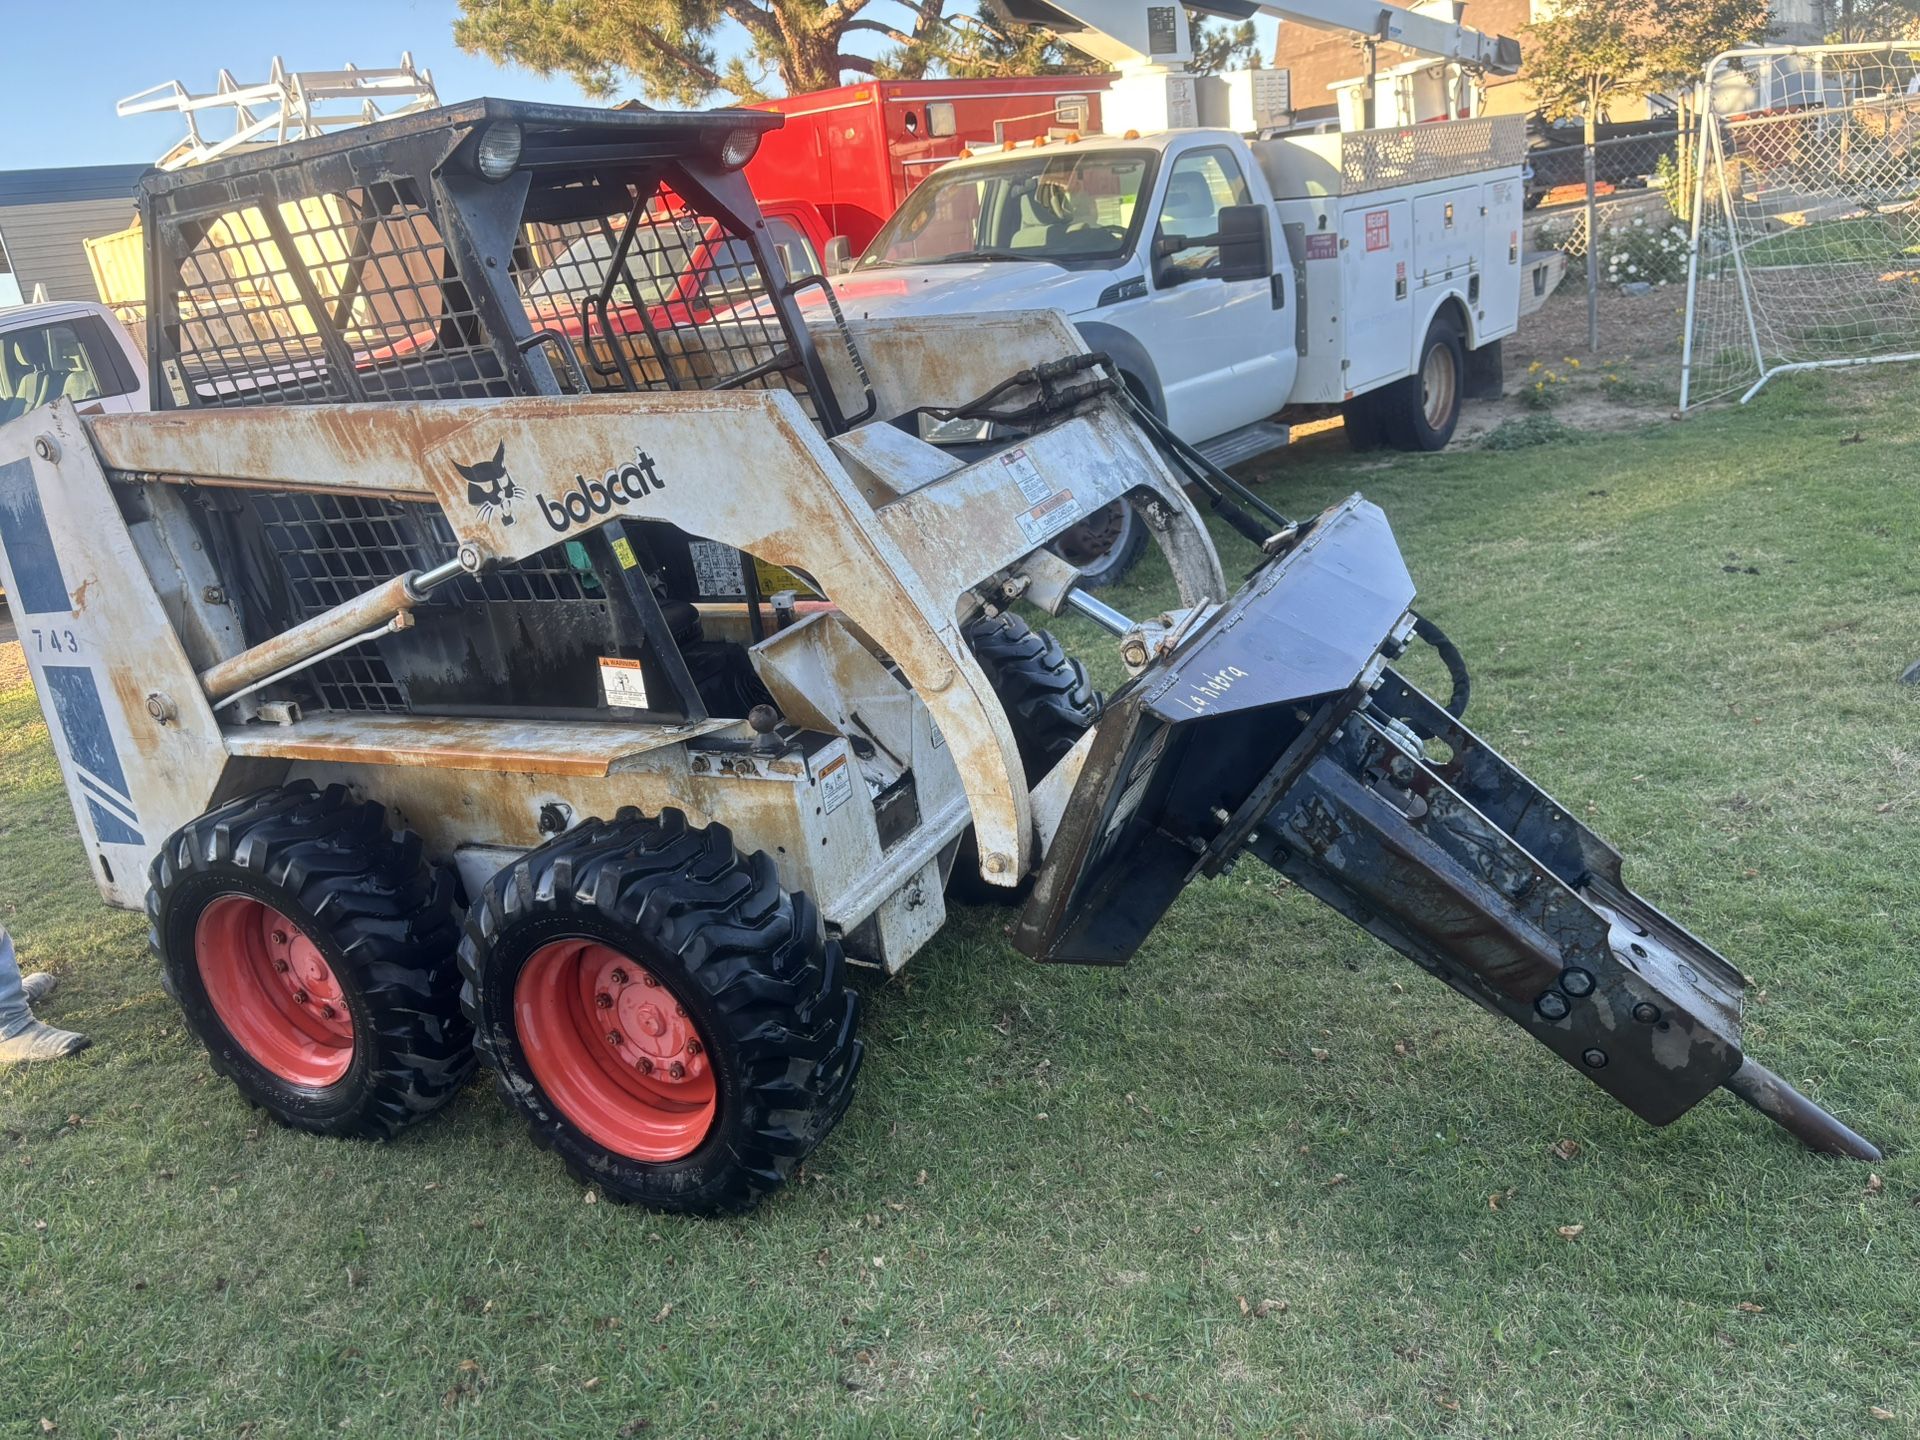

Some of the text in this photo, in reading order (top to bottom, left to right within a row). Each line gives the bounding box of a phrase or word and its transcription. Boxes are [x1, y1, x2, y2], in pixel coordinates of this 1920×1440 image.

[535, 451, 666, 532] bobcat
[31, 629, 78, 653] 743
[1174, 695, 1210, 714] La
